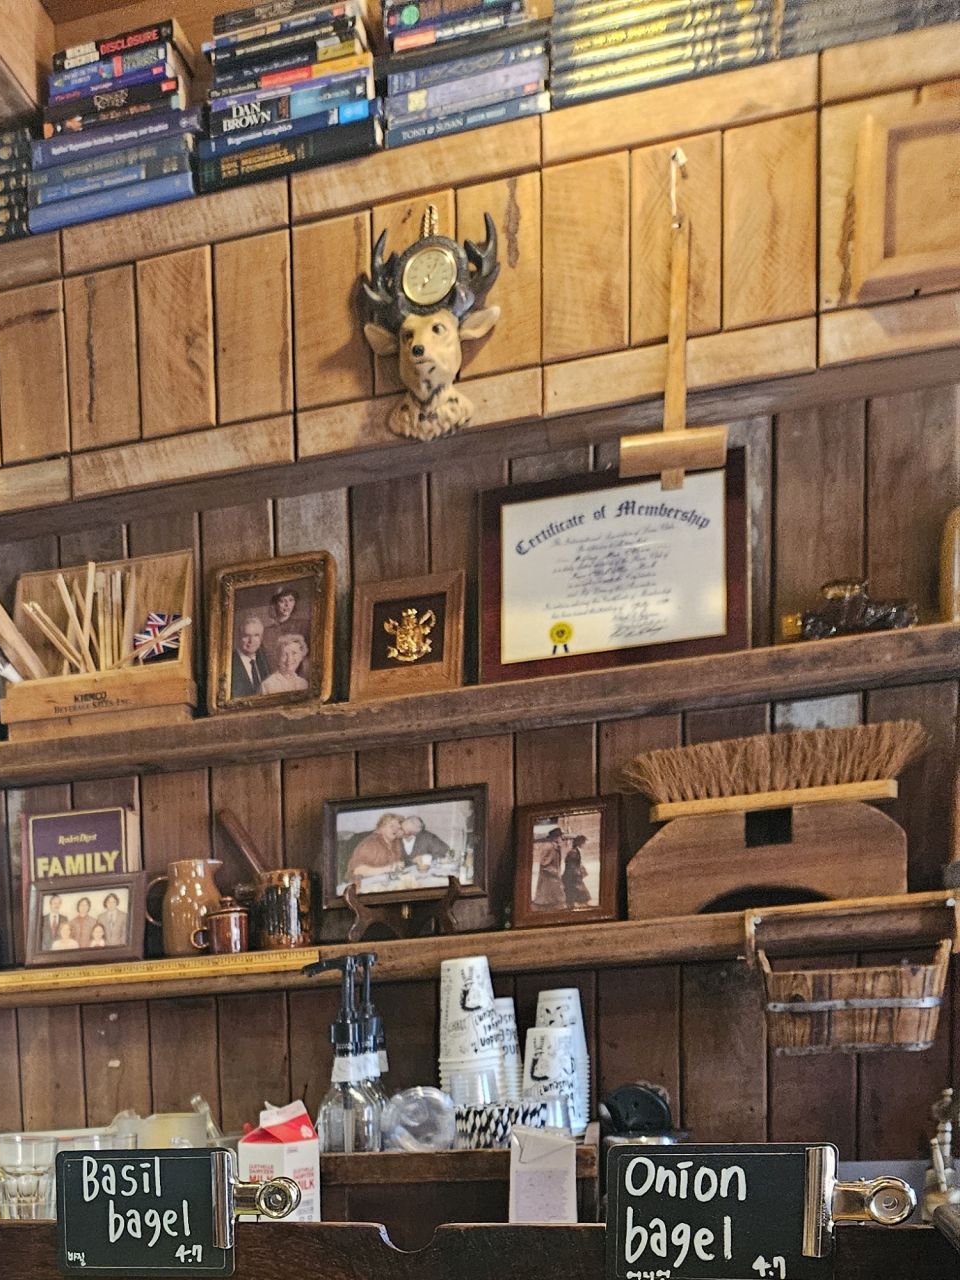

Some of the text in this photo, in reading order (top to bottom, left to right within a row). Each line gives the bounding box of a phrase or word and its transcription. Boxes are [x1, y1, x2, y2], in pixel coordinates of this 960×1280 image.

[222, 111, 271, 132] BROWN
[232, 102, 261, 118] DAN
[515, 500, 711, 556] Certificate of Membership
[36, 850, 120, 879] FAMILY
[82, 1156, 161, 1202] Basil
[625, 1156, 747, 1202] Onion
[109, 1200, 191, 1247] bagel
[625, 1206, 733, 1268] bagel
[67, 1251, 87, 1267] 바질
[175, 1244, 202, 1263] 4.7
[752, 1255, 787, 1280] 4.7
